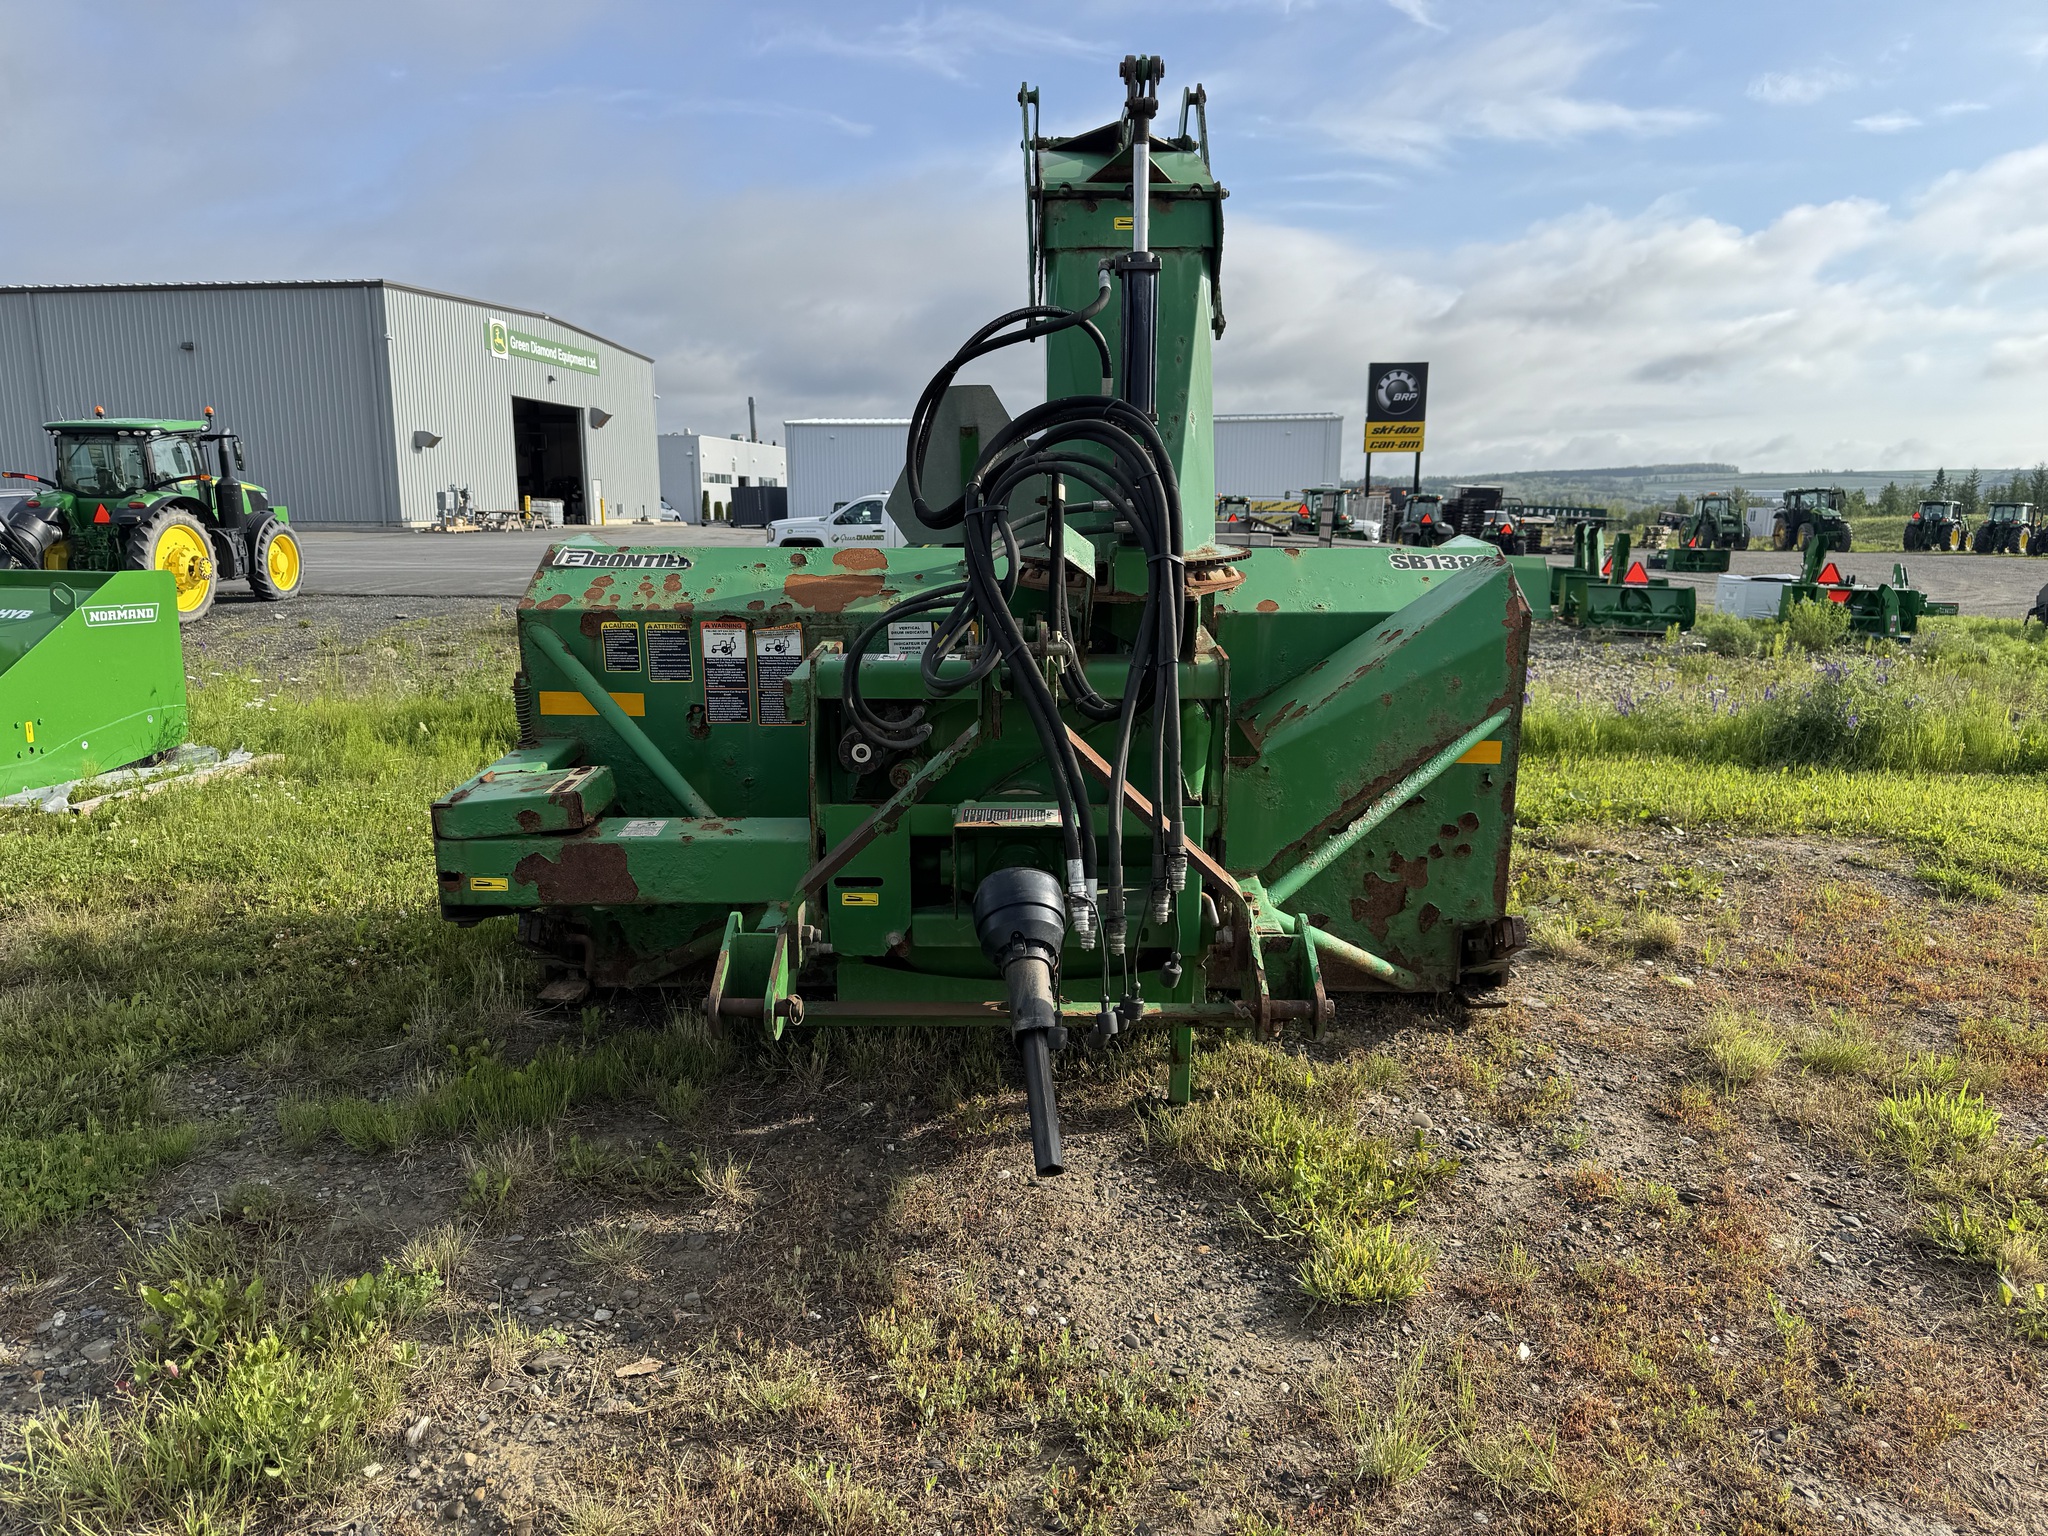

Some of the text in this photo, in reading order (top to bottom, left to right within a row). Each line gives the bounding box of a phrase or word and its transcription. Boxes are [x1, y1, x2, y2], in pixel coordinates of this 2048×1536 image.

[510, 336, 598, 369] Green Diamond Equipment Ltd.
[1393, 392, 1418, 402] BRP
[1371, 425, 1420, 435] ski-doo
[1369, 440, 1420, 449] can-am
[1388, 553, 1492, 571] SB138
[89, 607, 155, 622] NORMAND
